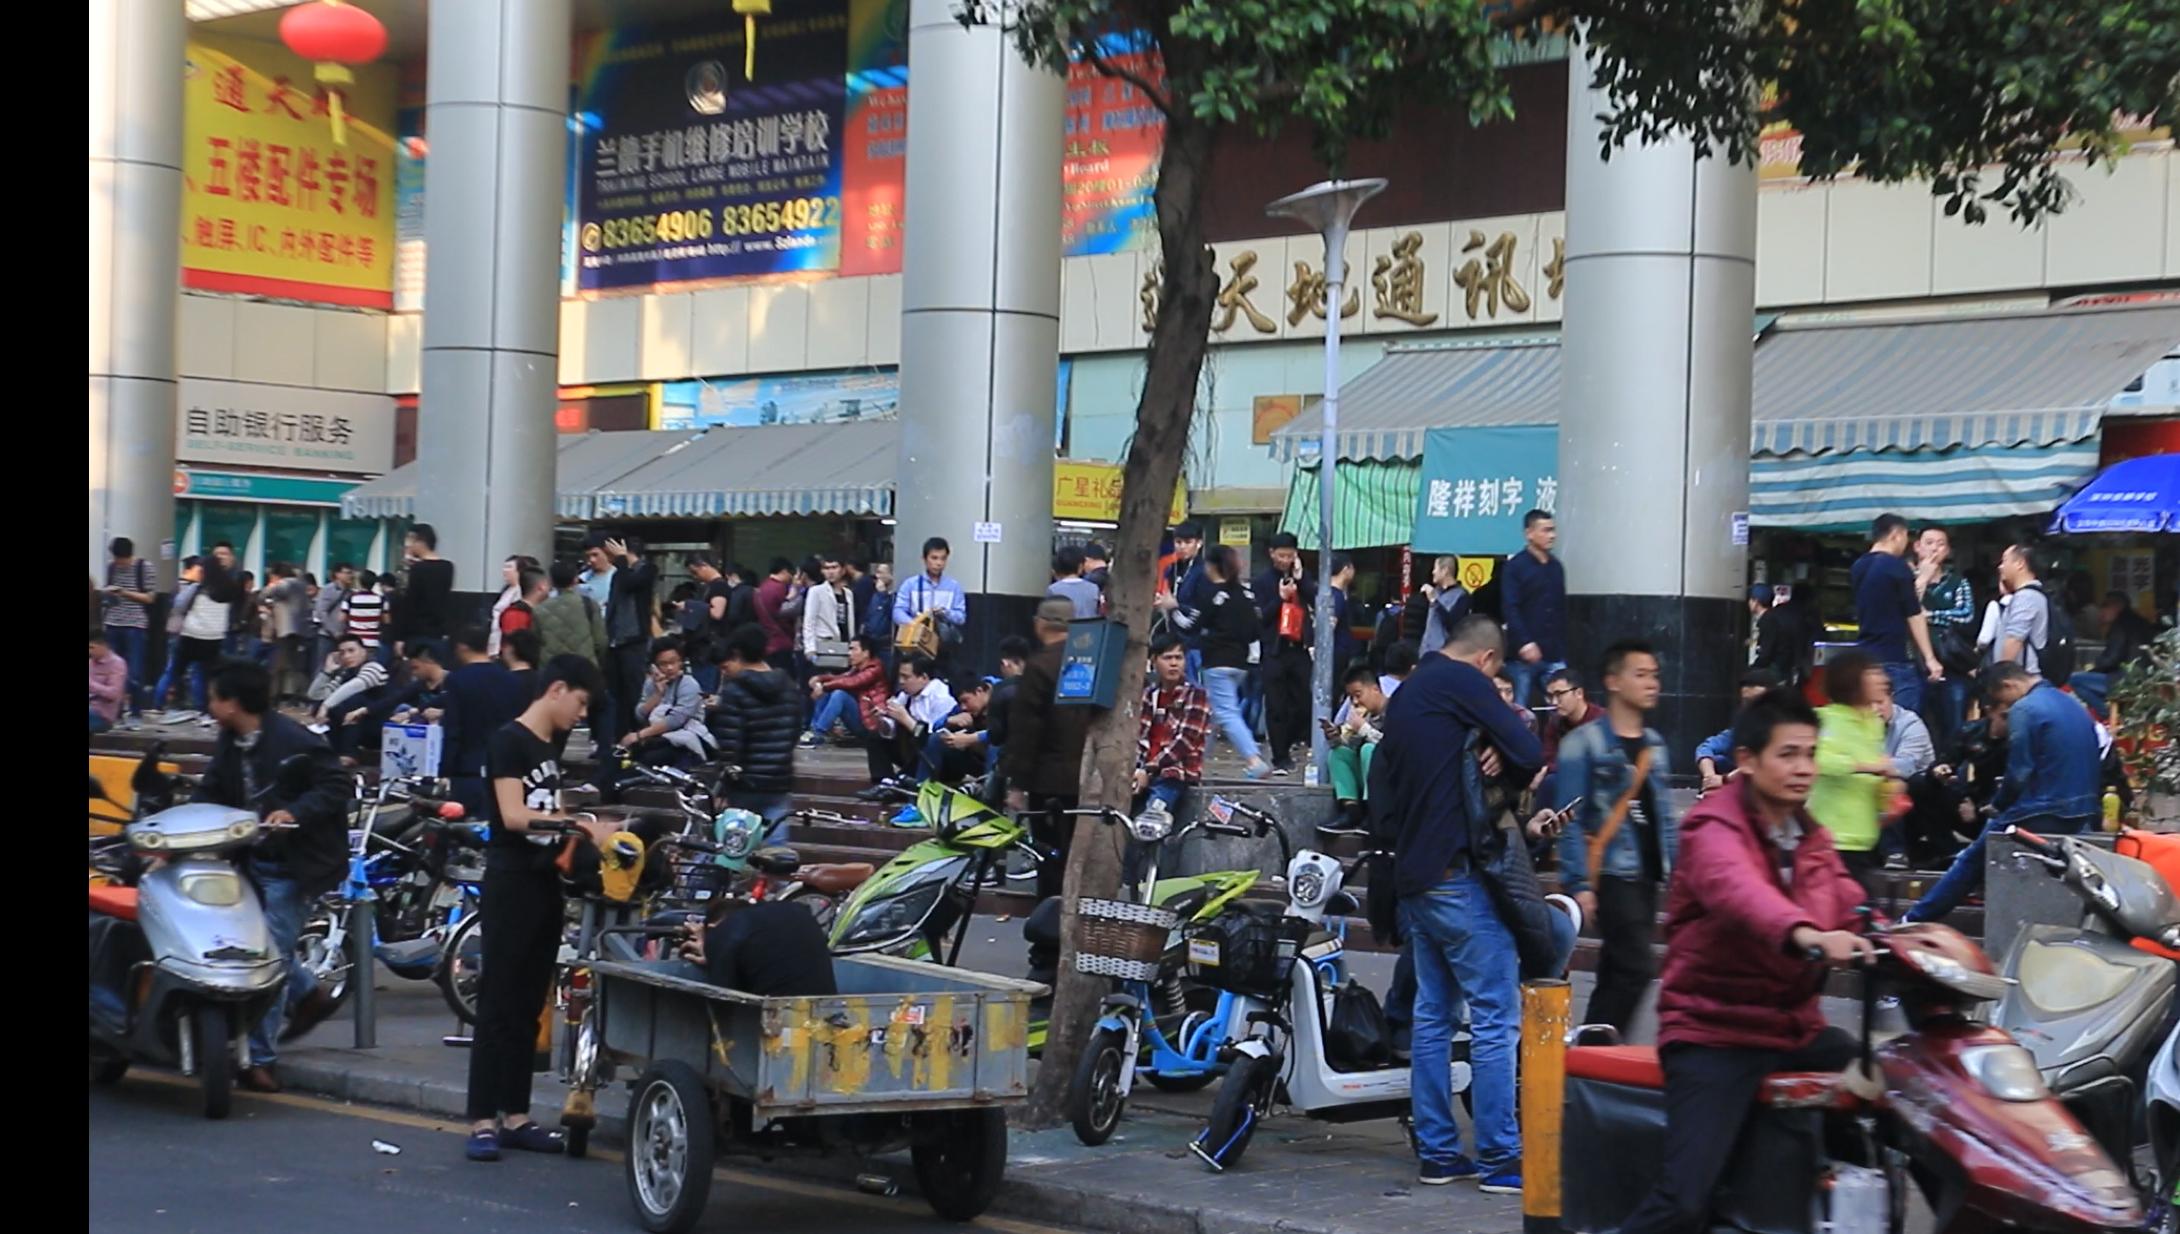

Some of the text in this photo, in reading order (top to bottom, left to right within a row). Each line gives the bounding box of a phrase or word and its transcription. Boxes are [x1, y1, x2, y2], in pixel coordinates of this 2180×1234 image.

[602, 208, 713, 249] 83654906
[722, 196, 840, 236] 83654922
[187, 406, 355, 445] 自助银行服务
[1426, 477, 1524, 518] 隆祥刻字
